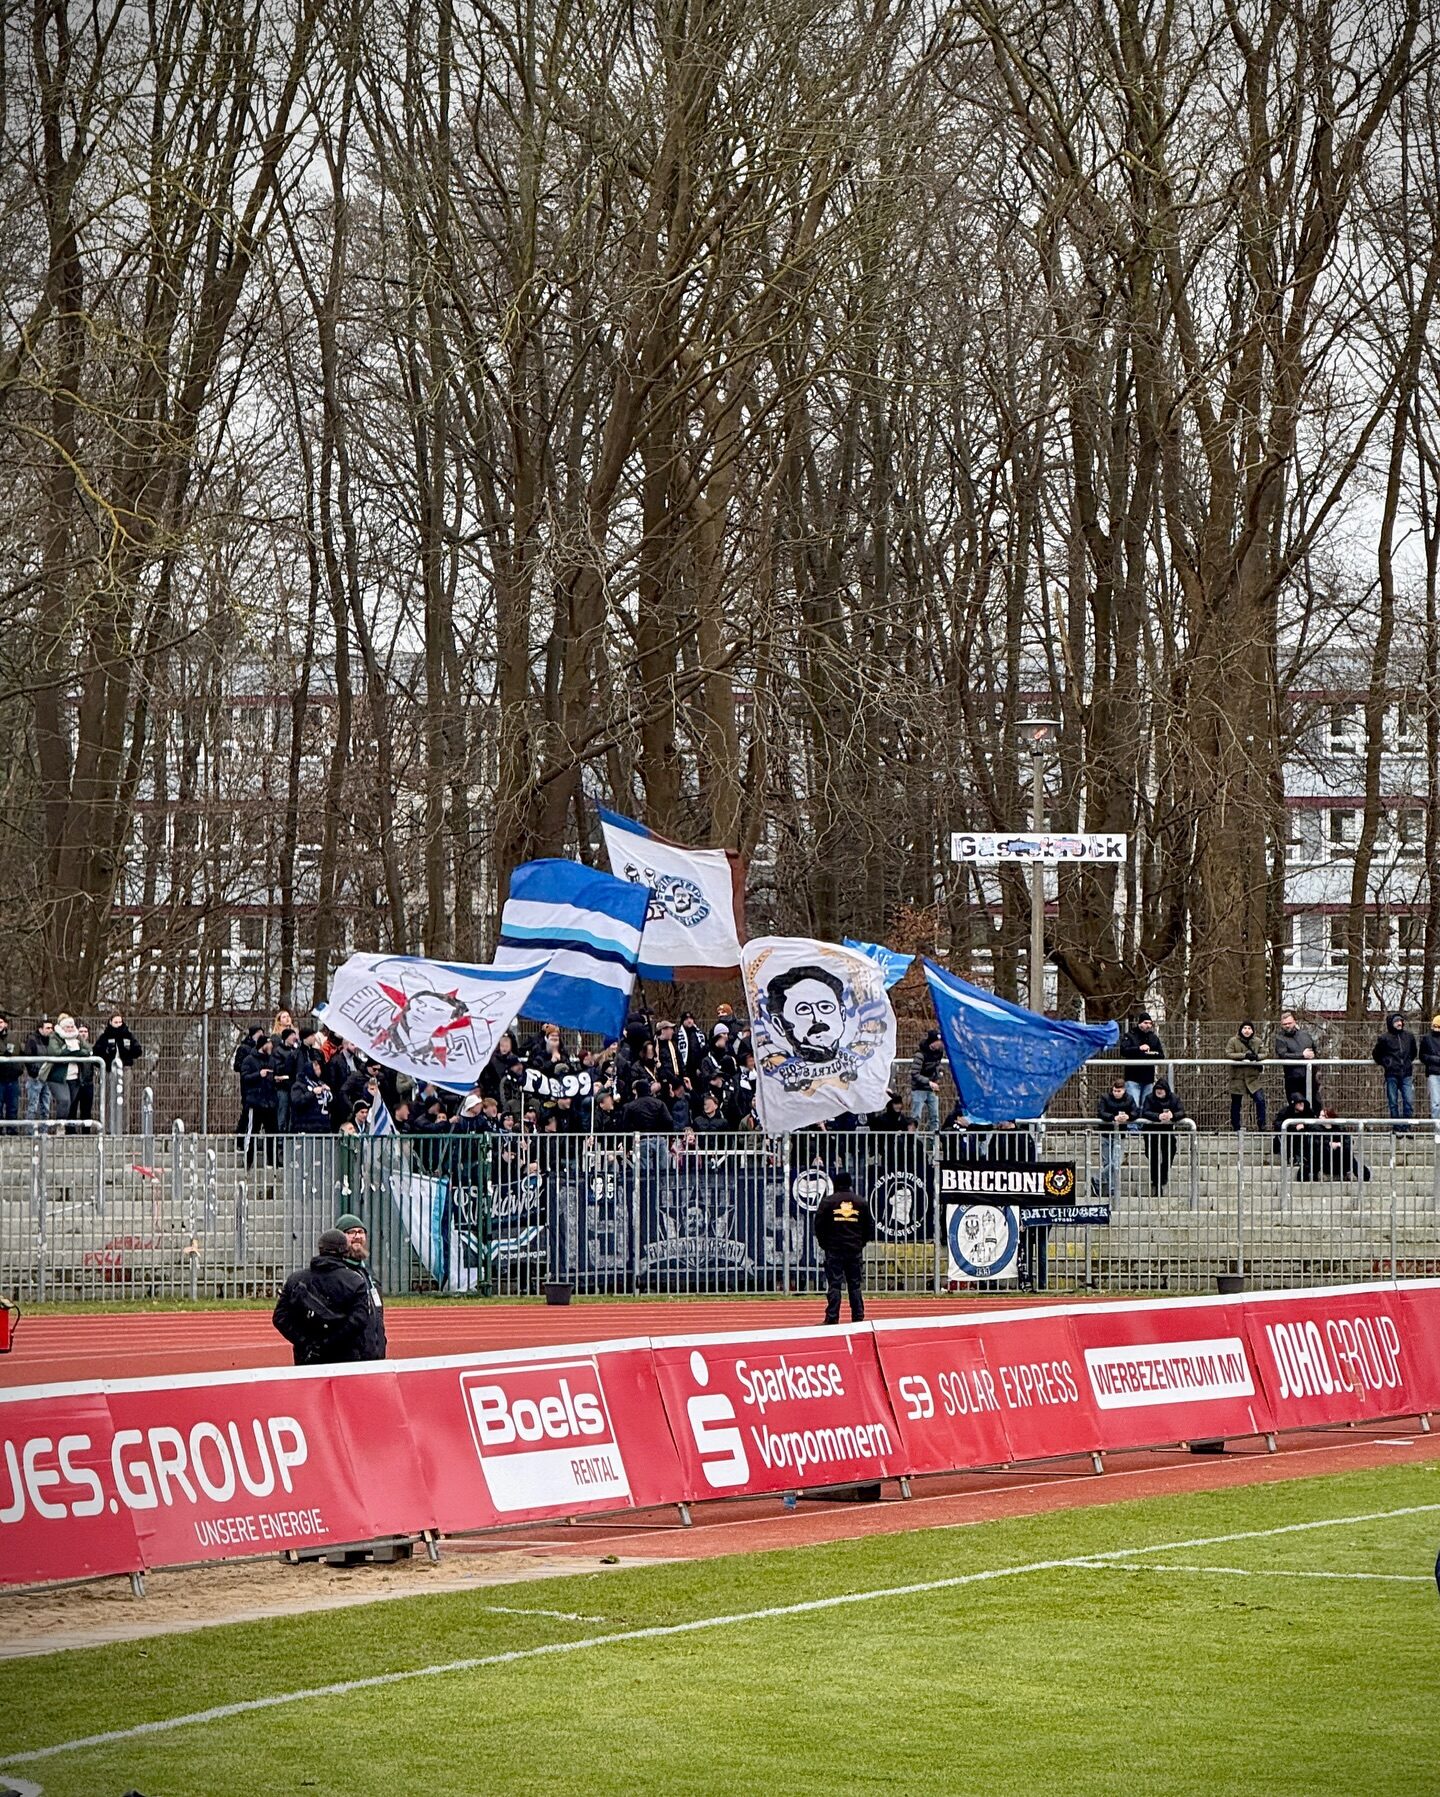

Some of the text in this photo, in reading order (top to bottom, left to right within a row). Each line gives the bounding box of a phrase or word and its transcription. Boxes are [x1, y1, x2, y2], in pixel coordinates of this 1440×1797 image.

[942, 1169, 1046, 1193] BRICCONI
[736, 1355, 845, 1414] Sparkasse
[938, 1360, 1079, 1416] SOLAR EXPRESS
[1091, 1352, 1246, 1395] WERBEZENTRUM MV
[469, 1379, 605, 1446] Boels
[571, 1456, 619, 1486] RENTAL
[751, 1423, 893, 1477] Vorpommern
[195, 1508, 330, 1547] UNSERE ENERGIE.
